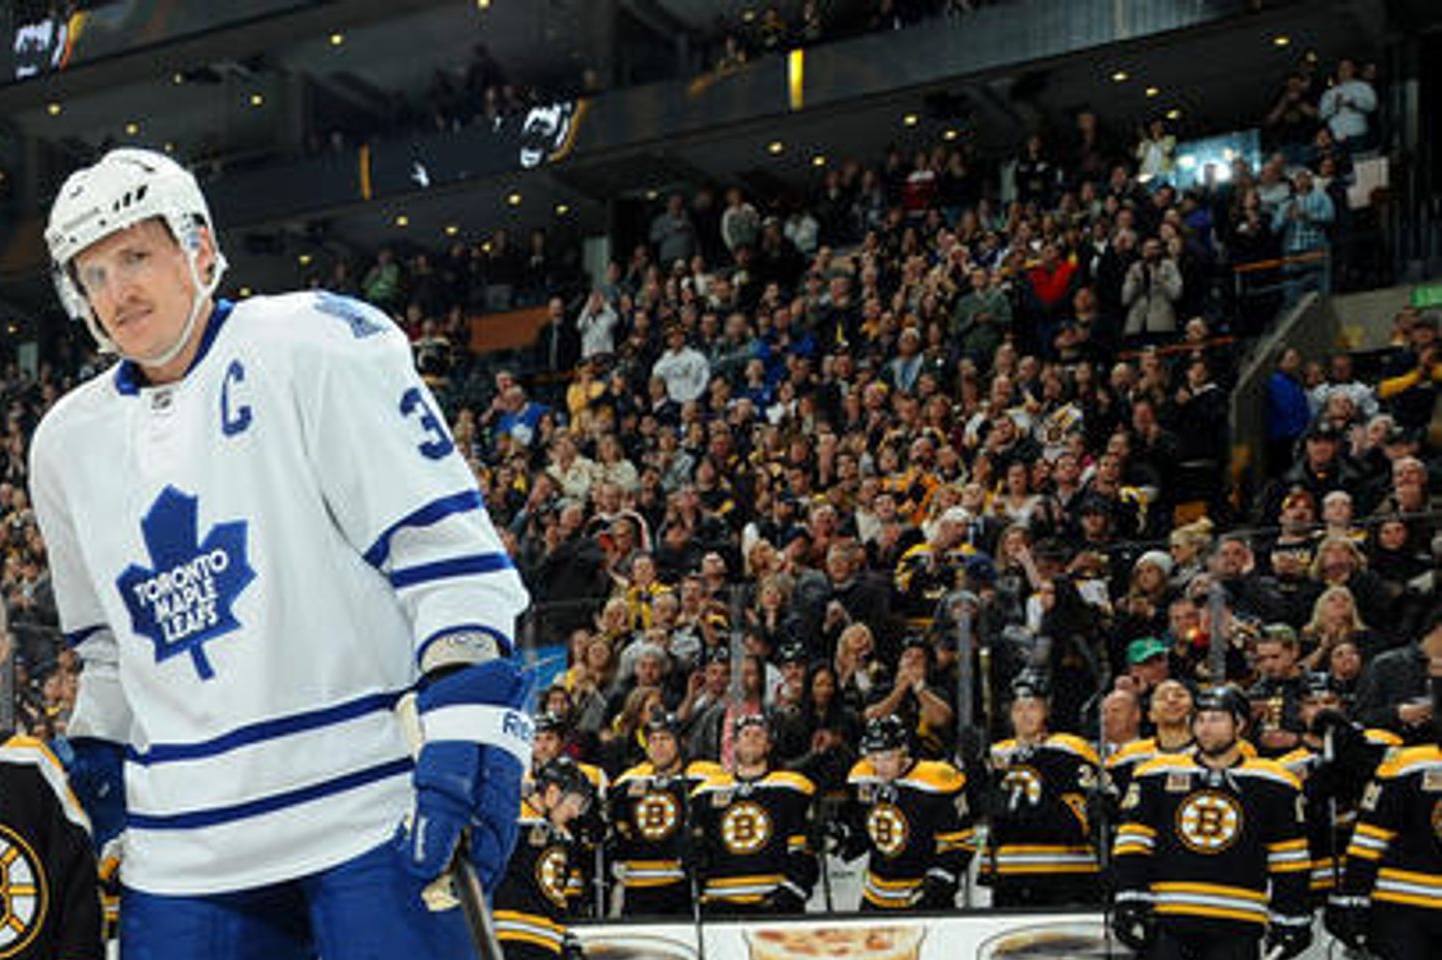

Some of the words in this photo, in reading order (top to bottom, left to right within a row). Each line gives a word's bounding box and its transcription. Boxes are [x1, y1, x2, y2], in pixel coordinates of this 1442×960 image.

[221, 359, 252, 437] C
[399, 387, 454, 460] 3
[133, 548, 229, 608] TORONTO
[153, 575, 218, 624] MAPLE
[162, 602, 219, 643] LEAFS
